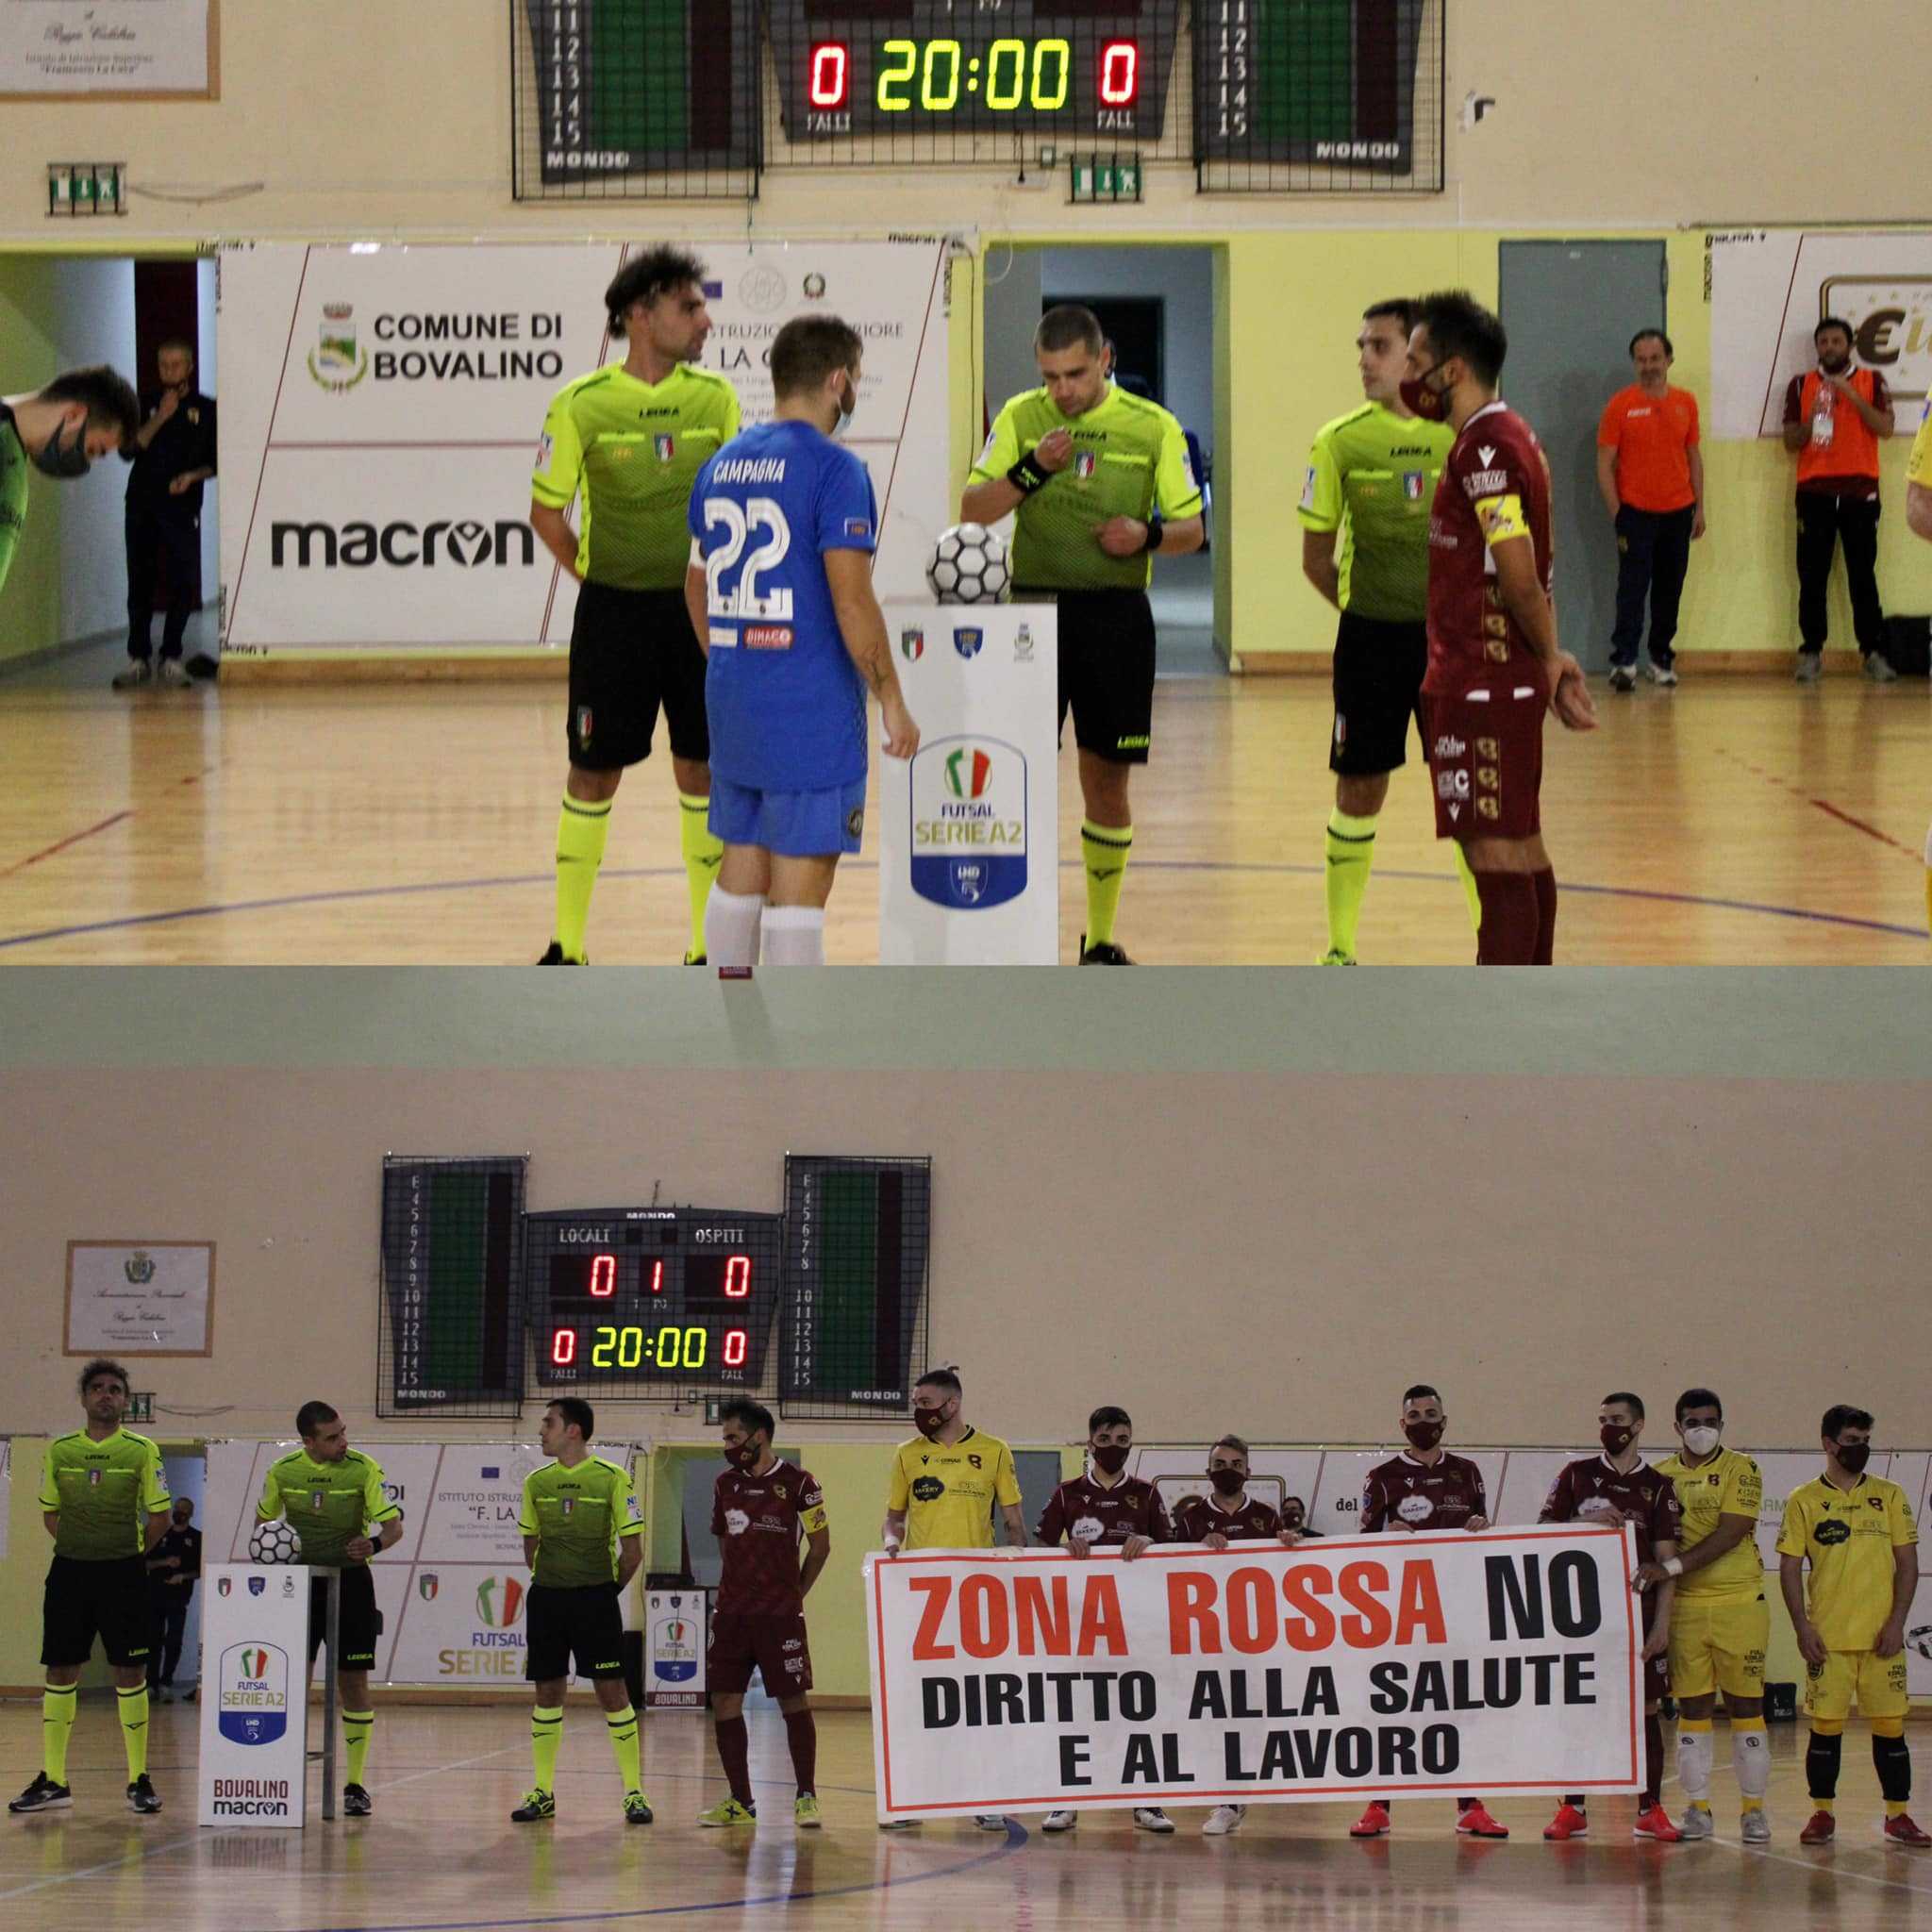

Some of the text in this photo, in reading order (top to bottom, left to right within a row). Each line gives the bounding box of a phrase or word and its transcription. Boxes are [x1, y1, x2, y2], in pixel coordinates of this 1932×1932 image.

[552, 8, 579, 31] 11
[551, 37, 580, 61] 12
[1219, 27, 1247, 53] 12
[551, 64, 580, 90] 13
[811, 39, 1136, 111] 0 20:00 0
[1219, 57, 1247, 80] 13
[551, 91, 580, 117] 14
[1218, 85, 1247, 109] 14
[551, 120, 581, 145] 15
[1218, 112, 1247, 137] 15
[546, 151, 630, 168] MONDO
[1316, 142, 1400, 159] MONDO
[375, 314, 562, 340] COMUNE DI
[375, 351, 563, 379] BOVALINO
[720, 347, 751, 370] LA
[713, 458, 786, 484] CAMPAGNA
[272, 520, 534, 567] macron
[704, 497, 793, 621] 22
[941, 803, 995, 819] FUTSAL
[915, 821, 1023, 846] SERIE A2
[559, 1228, 611, 1243] LOCALI
[695, 1228, 744, 1243] OSPITI
[591, 1256, 615, 1295] 0
[653, 1260, 662, 1291] 1
[725, 1257, 750, 1297] 0
[402, 1323, 420, 1336] 12
[794, 1323, 812, 1336] 12
[402, 1339, 419, 1352] 13
[554, 1327, 746, 1368] 0 20:00 0
[794, 1339, 811, 1352] 13
[401, 1372, 419, 1385] 15
[793, 1372, 810, 1386] 15
[851, 1391, 901, 1401] MONDO
[438, 1492, 485, 1503] ISTITUTO
[1336, 1498, 1358, 1512] del
[497, 1507, 515, 1521] LA
[909, 1551, 1602, 1660] ZONA ROSSA NO
[472, 1633, 526, 1647] FUTSAL
[438, 1649, 516, 1676] SERIE
[237, 1681, 270, 1691] FUTSAL
[923, 1653, 1597, 1729] DIRITTO ALLA SALUTE
[222, 1691, 285, 1707] SERIE A2
[1059, 1724, 1459, 1786] E AL LAVORO
[214, 1779, 289, 1798] BOVALINO
[214, 1801, 288, 1816] macron
